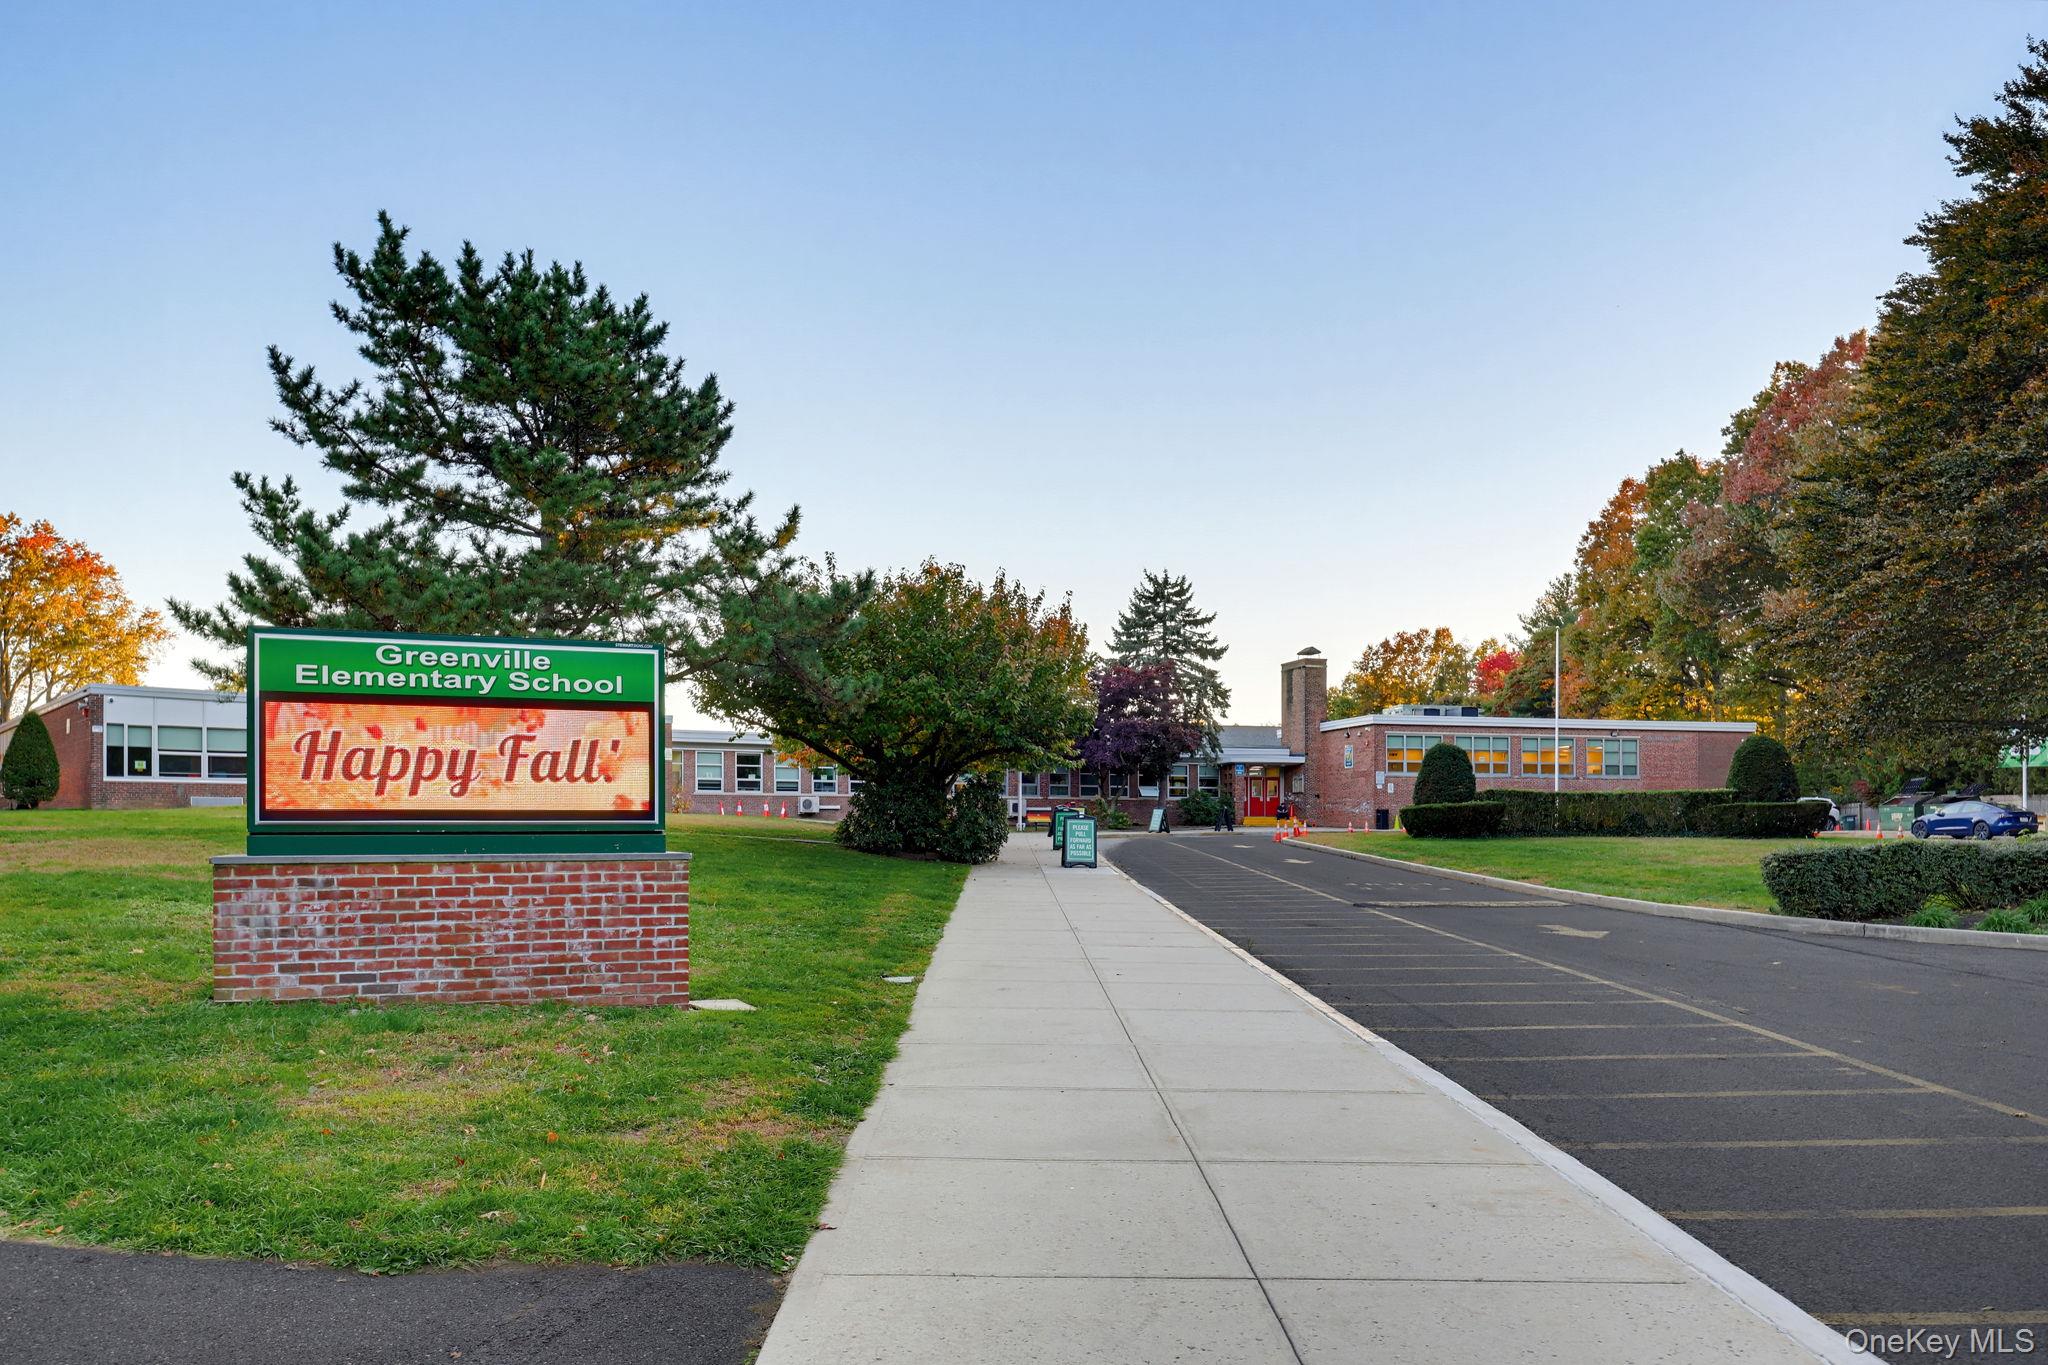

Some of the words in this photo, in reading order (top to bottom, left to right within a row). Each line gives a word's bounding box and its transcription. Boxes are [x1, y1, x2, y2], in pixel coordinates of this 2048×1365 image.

[375, 644, 551, 671] Greenville
[295, 663, 497, 695] Elementary
[508, 671, 623, 695] School
[293, 728, 481, 798] Happy
